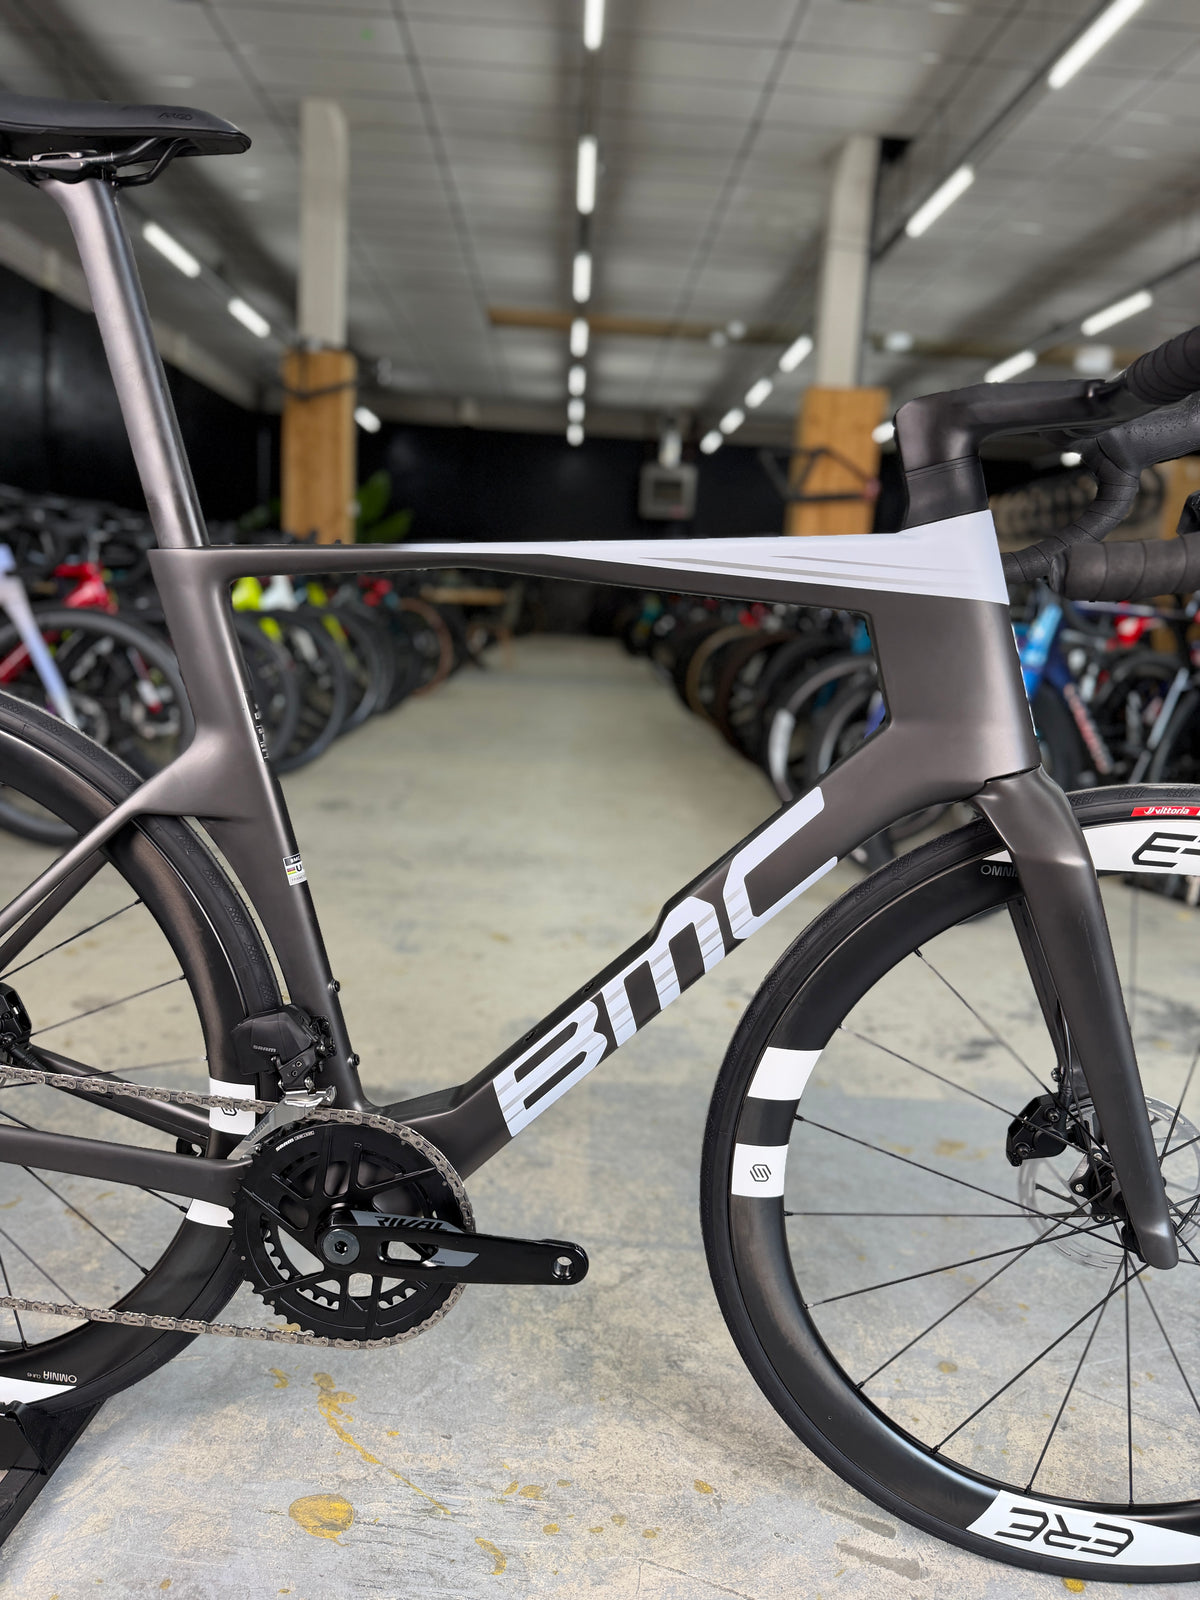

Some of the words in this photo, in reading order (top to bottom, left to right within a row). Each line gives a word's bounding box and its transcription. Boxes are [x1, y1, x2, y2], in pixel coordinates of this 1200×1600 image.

[1156, 806, 1190, 816] vittoria
[980, 864, 1018, 878] OMNI
[493, 786, 838, 1138] BMC
[374, 1215, 448, 1232] RIVAL
[43, 1370, 77, 1384] OMNIA
[994, 1506, 1134, 1558] ERE
